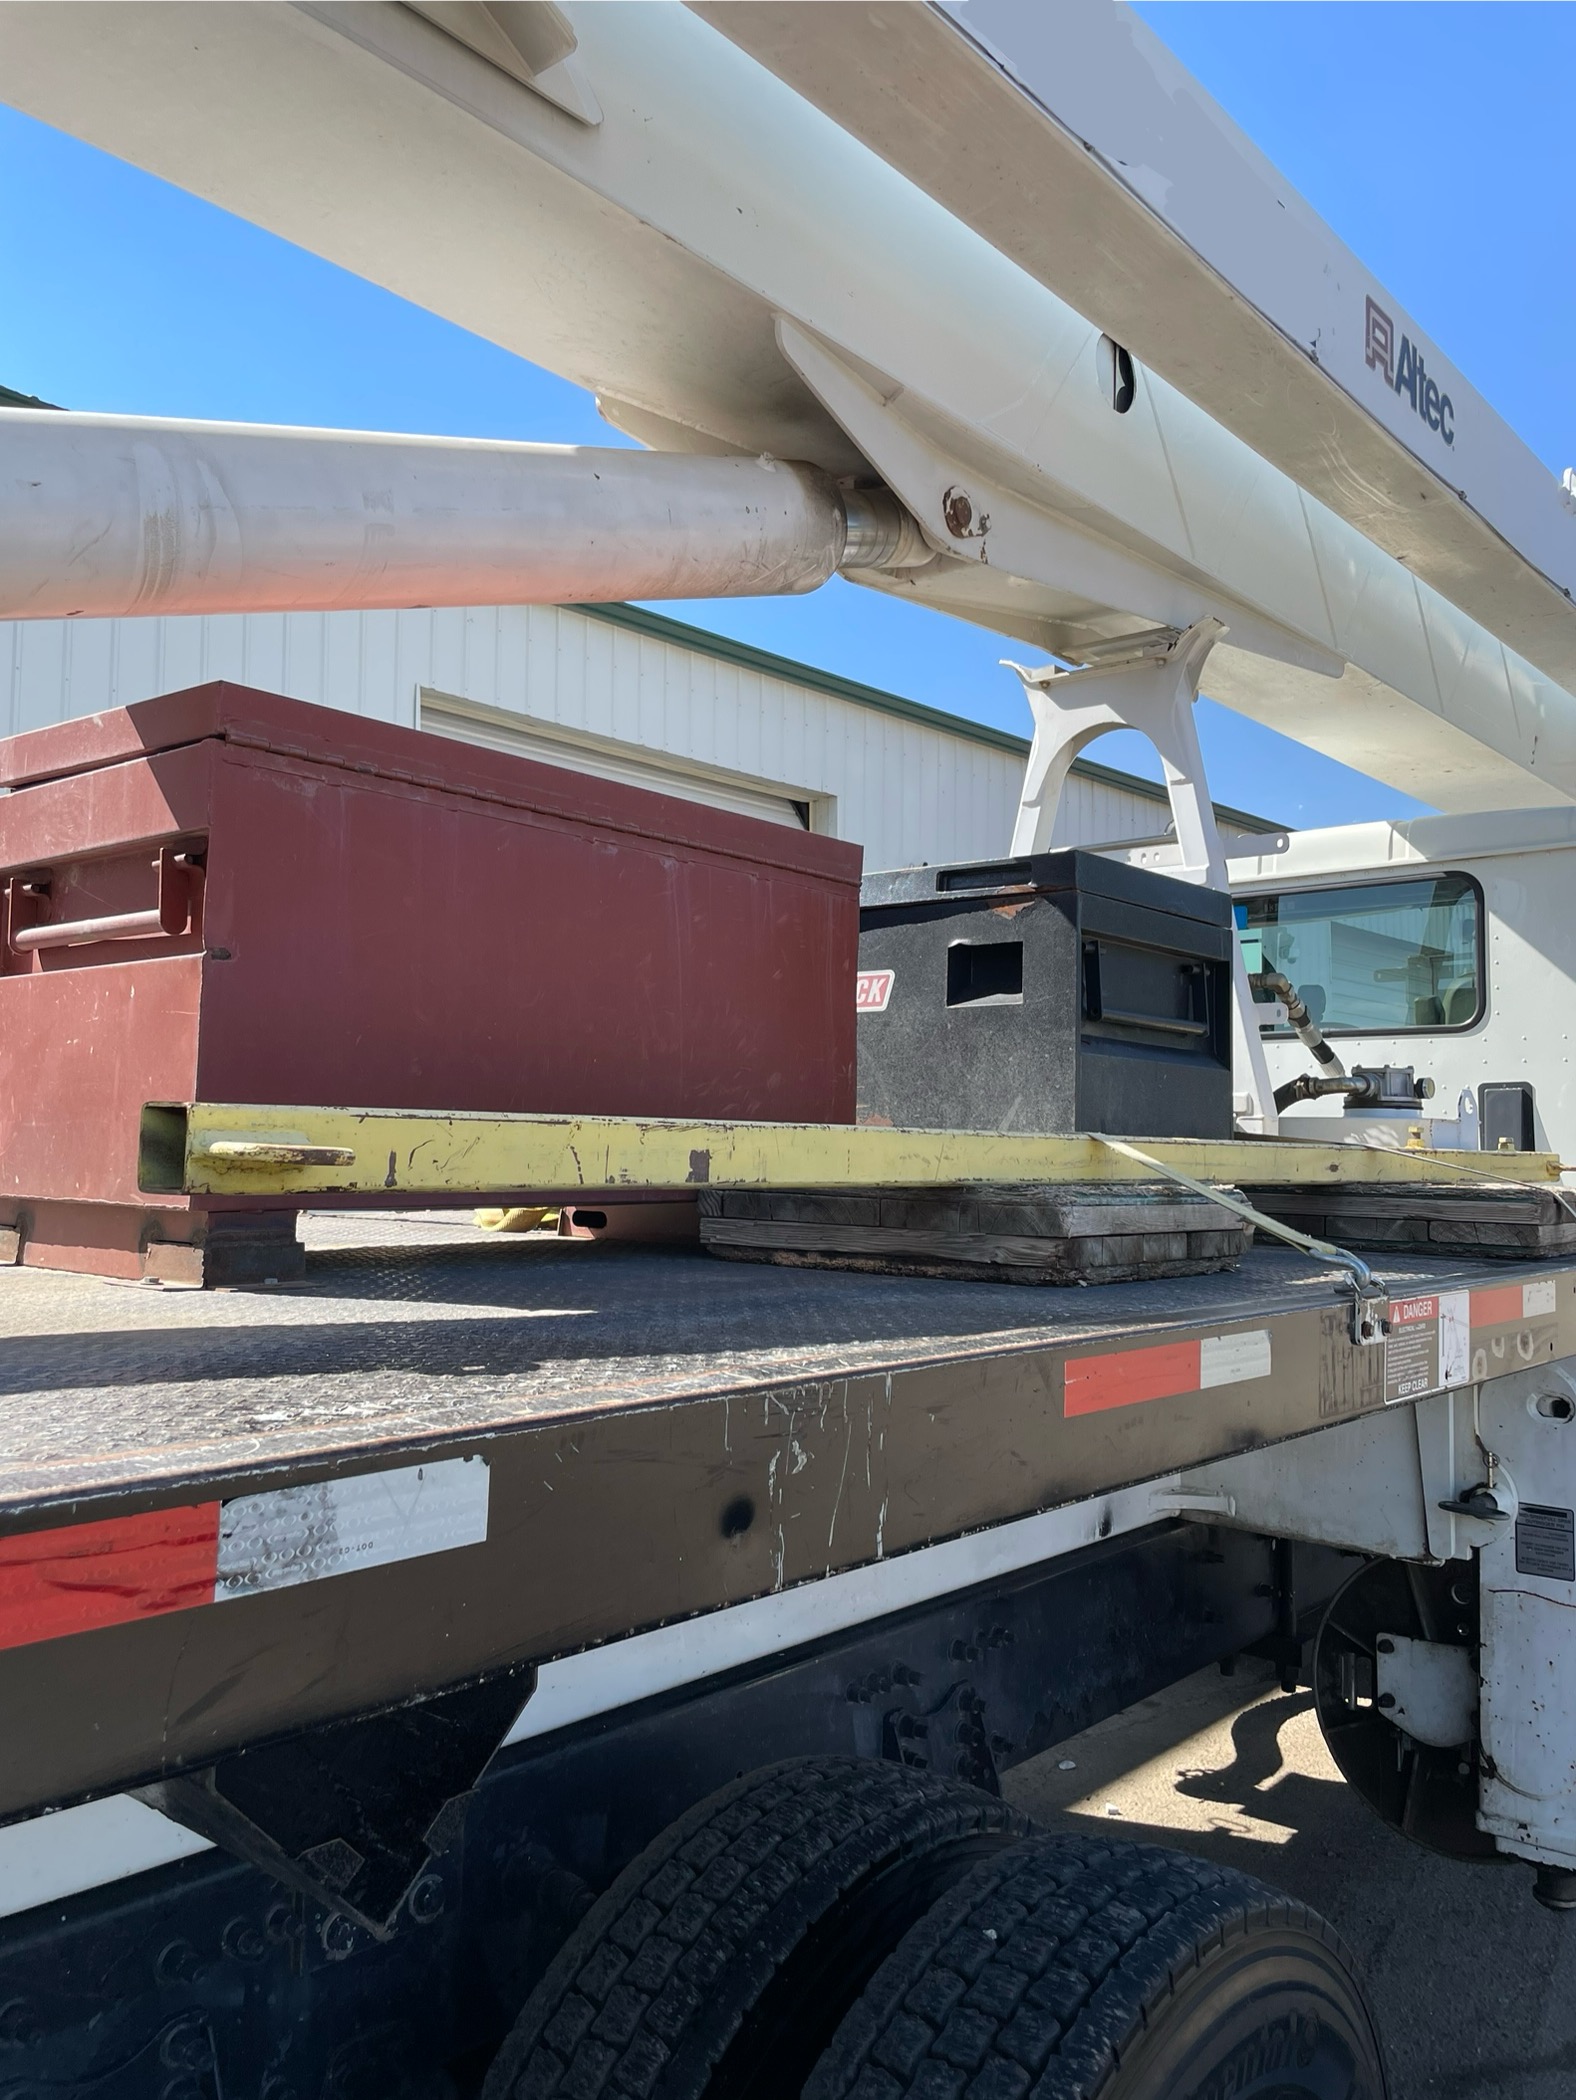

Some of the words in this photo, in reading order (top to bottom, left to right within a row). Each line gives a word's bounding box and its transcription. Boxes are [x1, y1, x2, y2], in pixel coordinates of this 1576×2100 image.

[1394, 333, 1455, 445] Altec
[1403, 1301, 1432, 1319] DANGER
[1398, 1382, 1411, 1394] KEEP
[1412, 1377, 1428, 1391] CLEAR
